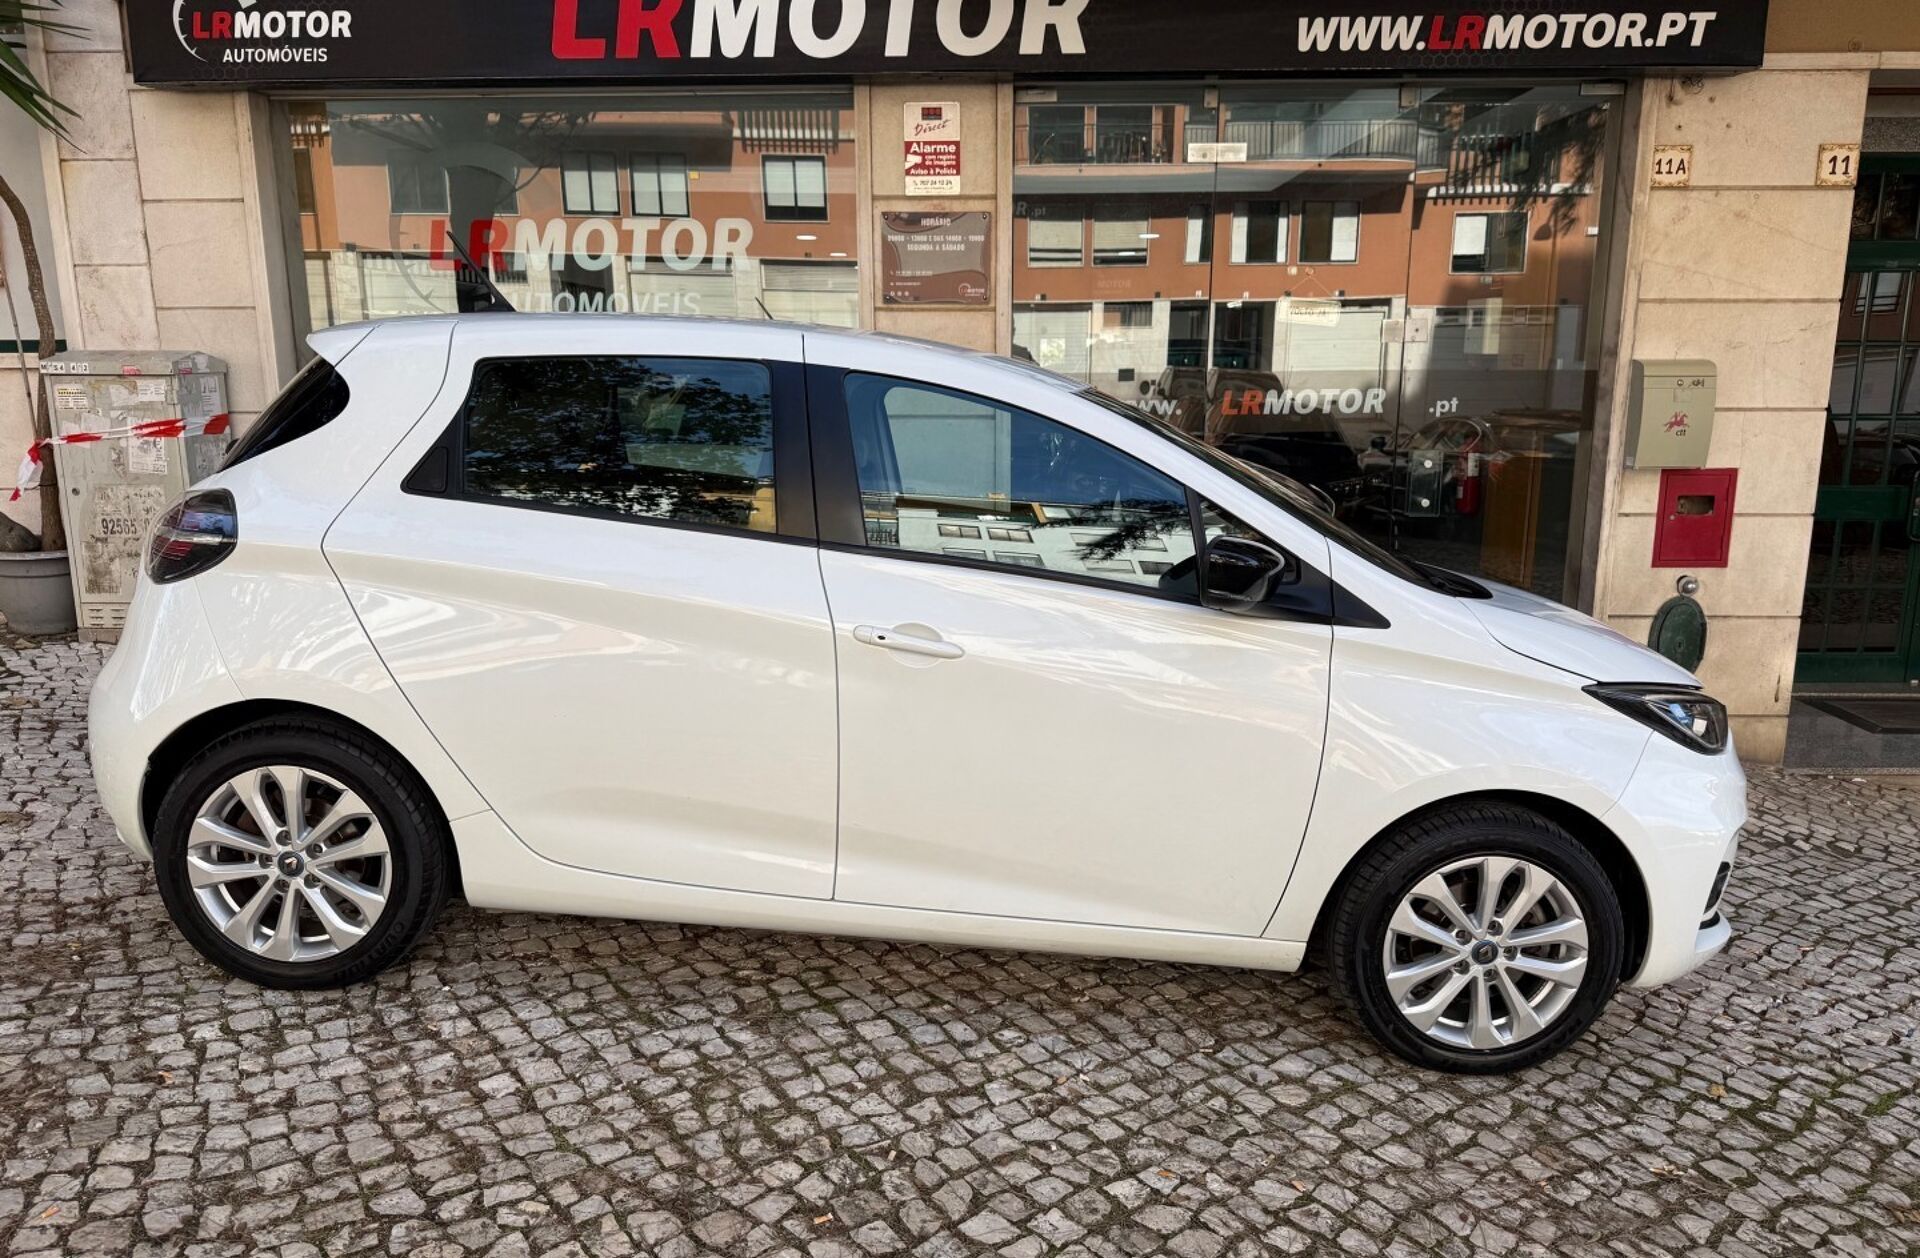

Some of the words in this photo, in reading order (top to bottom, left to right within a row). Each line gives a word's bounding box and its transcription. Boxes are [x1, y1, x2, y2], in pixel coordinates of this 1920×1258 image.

[192, 10, 352, 39] LRMOTOR
[552, 0, 1087, 58] LRMOTOR
[1298, 12, 1717, 52] WWW.LRMOTOR.PT
[222, 45, 328, 63] AUTOMÓVEIS
[914, 119, 951, 136] Direct
[910, 142, 956, 153] Alarme
[1655, 158, 1686, 175] 11A
[1828, 155, 1850, 175] 11
[920, 217, 951, 226] HORÁRIO
[430, 217, 754, 271] LRMOTOR
[907, 243, 933, 251] SEGUNDA
[508, 286, 703, 315] UTOMÓVEIS
[1222, 388, 1386, 415] LRMOTOR
[1428, 397, 1459, 417] .pt
[101, 518, 137, 535] 92565
